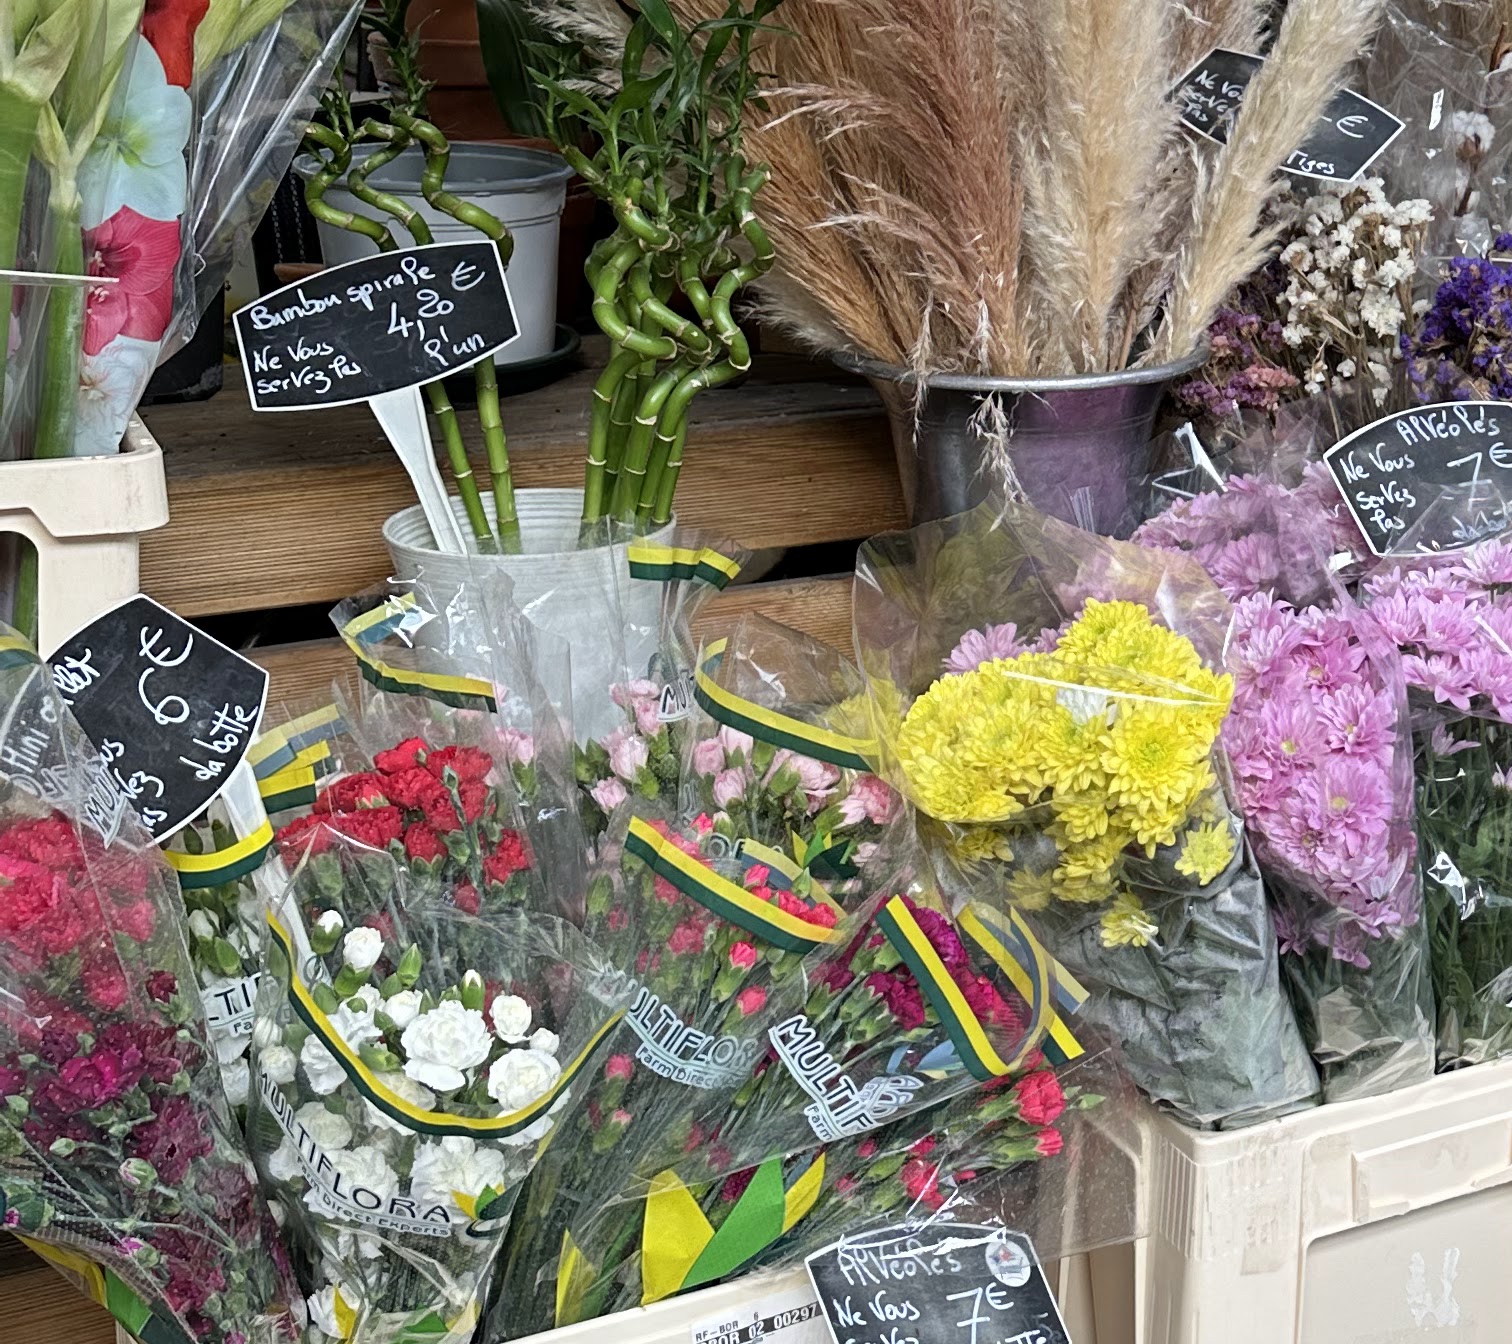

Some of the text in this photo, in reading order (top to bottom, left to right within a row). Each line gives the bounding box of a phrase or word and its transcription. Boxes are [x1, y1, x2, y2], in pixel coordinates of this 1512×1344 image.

[1336, 115, 1368, 139] €
[451, 261, 486, 291] €
[252, 336, 335, 373] Ne Vous
[1340, 442, 1415, 484] Ne Vous
[138, 626, 193, 726] 6 €
[778, 1018, 874, 1128] MULTIF
[833, 1291, 921, 1328] Ne Vous
[986, 1282, 1014, 1310] €
[749, 1321, 765, 1340] 02
[774, 1304, 817, 1330] 00297
